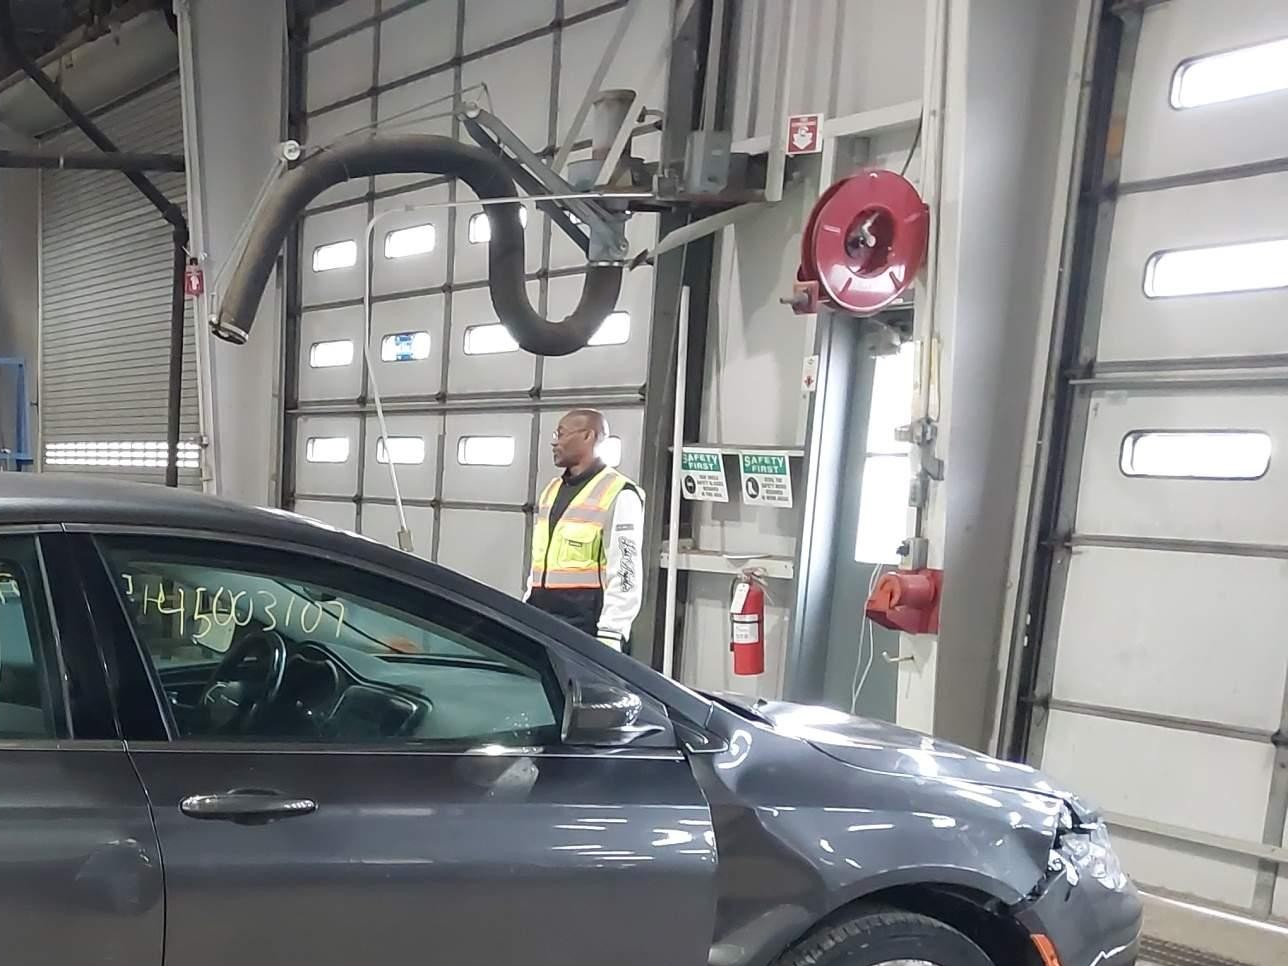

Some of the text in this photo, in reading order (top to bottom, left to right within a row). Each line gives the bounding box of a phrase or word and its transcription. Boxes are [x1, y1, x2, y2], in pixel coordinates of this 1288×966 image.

[682, 453, 718, 465] SAFETY
[744, 455, 784, 468] SAFETY
[688, 462, 714, 470] FIRST
[751, 465, 779, 473] FIRST
